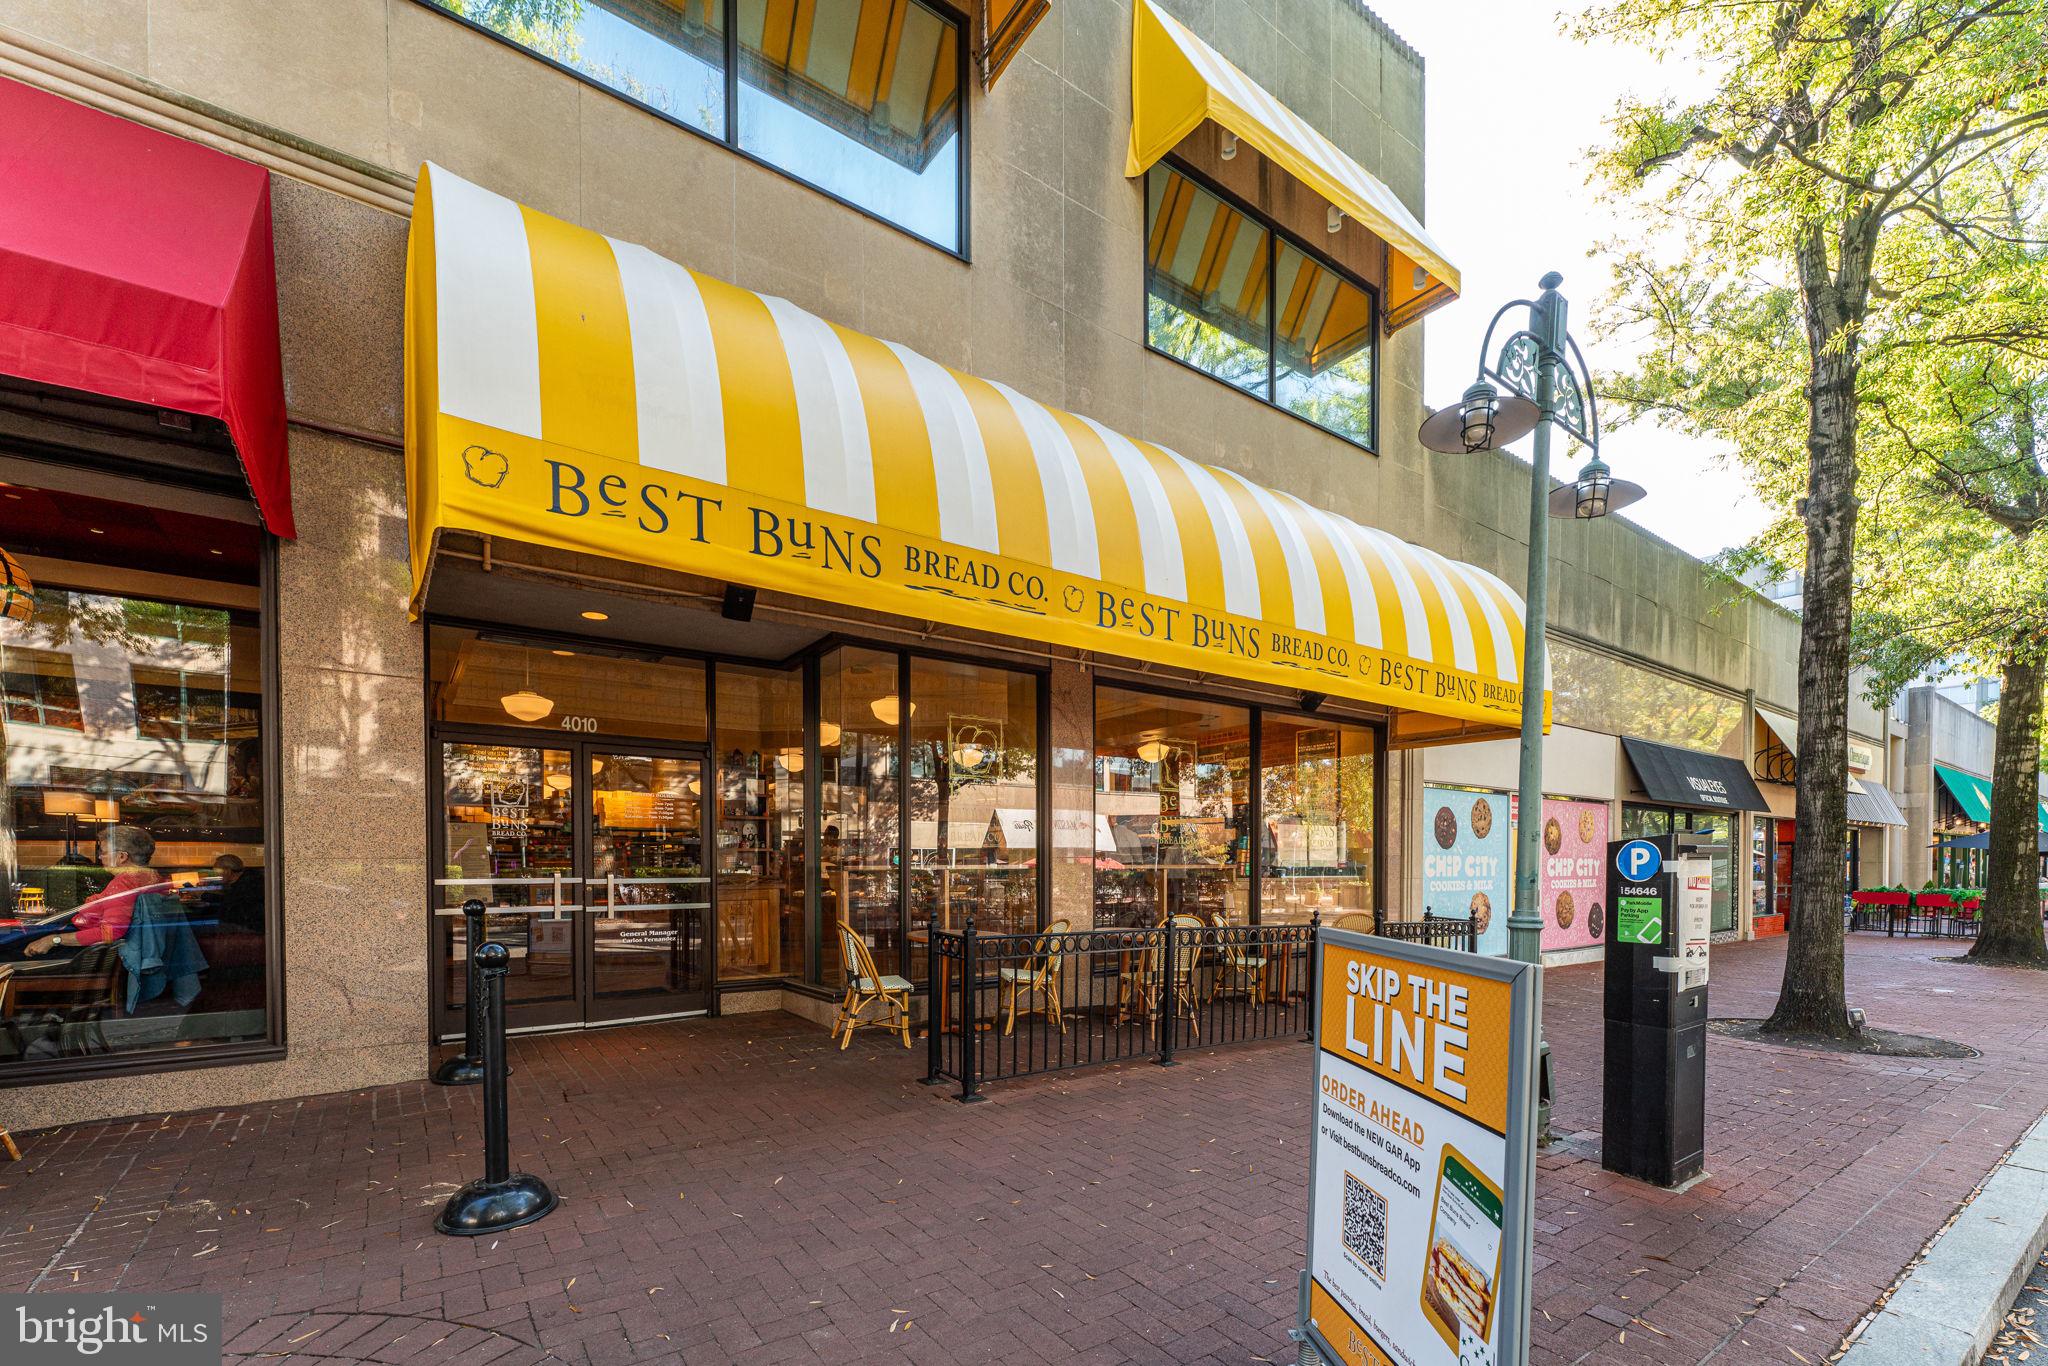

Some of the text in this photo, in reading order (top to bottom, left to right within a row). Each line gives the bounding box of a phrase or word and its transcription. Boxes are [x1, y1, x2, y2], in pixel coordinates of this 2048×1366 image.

[543, 459, 1049, 602] BeST BuNS BREAD CO.
[1096, 590, 1350, 668] BeST BuNS BREAD CO.
[1379, 657, 1428, 694] BeST
[1435, 671, 1476, 704] BuNS
[1483, 682, 1516, 704] BREAD
[561, 715, 598, 733] 4010
[1430, 880, 1465, 891] COOKIES
[1473, 879, 1493, 890] MILK
[1551, 879, 1576, 888] COOKIES
[1582, 878, 1597, 888] MILK
[1630, 847, 1650, 876] P
[1346, 960, 1469, 1030] SKIP THE
[1345, 994, 1469, 1104] LINE
[1321, 1074, 1425, 1146] ORDER AHEAD
[1322, 1102, 1421, 1173] Download the NEW GAR App
[1321, 1125, 1421, 1199] or Visit bestbunsbreadco.com
[1323, 1269, 1332, 1285] The
